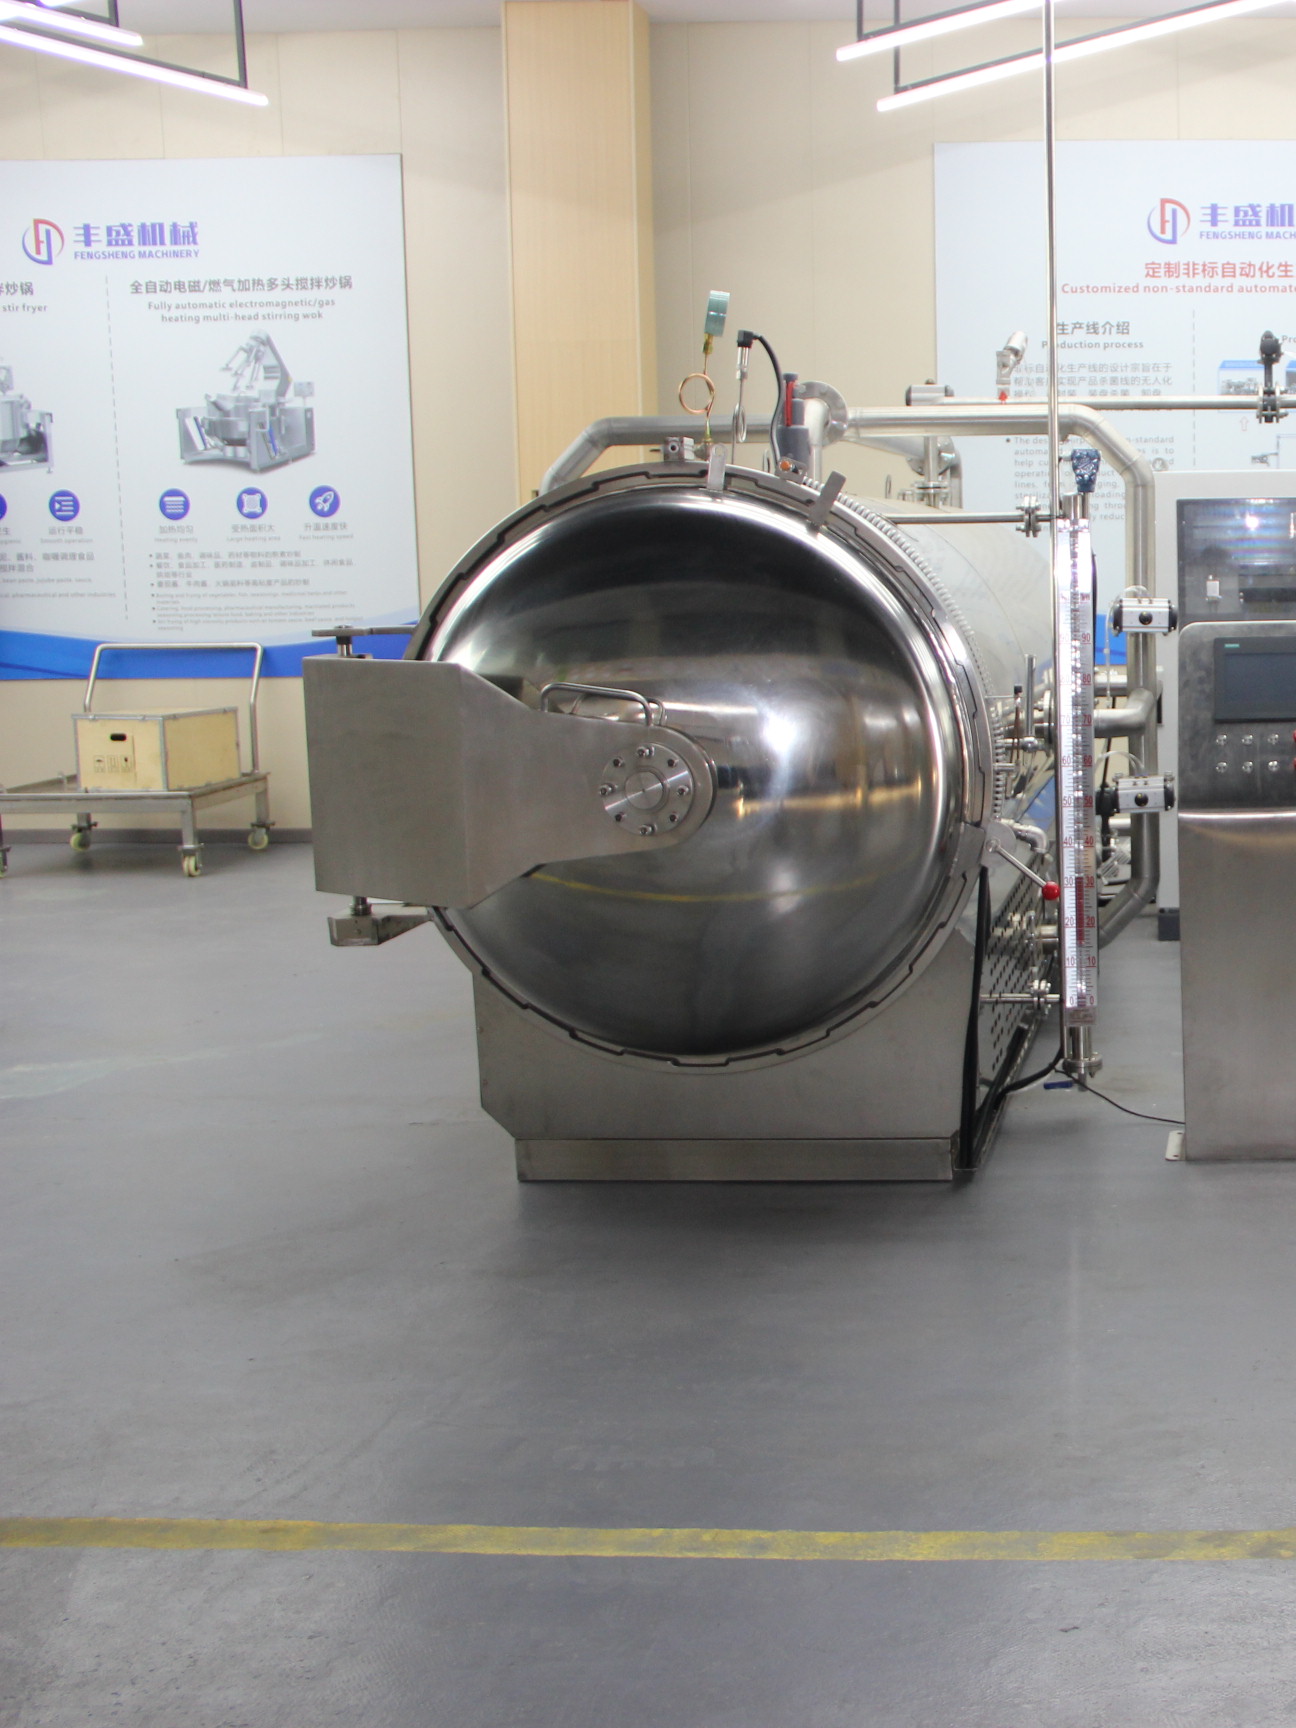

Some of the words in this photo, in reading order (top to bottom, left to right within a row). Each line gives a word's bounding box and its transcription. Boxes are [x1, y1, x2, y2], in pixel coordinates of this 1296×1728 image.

[72, 221, 199, 247] 丰盛机械
[1199, 230, 1263, 240] FENGSHENG
[73, 250, 135, 260] FENGSHENG
[138, 248, 200, 260] MACHINERY
[1061, 282, 1140, 294] Customized
[1143, 282, 1234, 294] non-standard
[2, 303, 20, 312] stir
[22, 303, 48, 314] fryer
[148, 300, 172, 312] Fully
[175, 299, 227, 310] automatic
[229, 297, 336, 309] electromagnetic/gas
[161, 313, 201, 324] heating
[202, 311, 260, 322] multi-head
[262, 310, 300, 322] stirring
[302, 309, 324, 320] wok
[1056, 320, 1131, 336] 生产线介绍
[1042, 340, 1101, 350] Pduction
[1103, 341, 1145, 351] process
[1081, 633, 1091, 643] 90
[1082, 674, 1092, 684] 80
[1083, 715, 1092, 725] 70
[1061, 756, 1071, 766] 60
[1062, 797, 1072, 806] 50
[1063, 837, 1073, 846] 40
[1084, 837, 1094, 846] 40
[1064, 876, 1074, 886] 30
[1085, 876, 1095, 886] 30
[1064, 916, 1074, 926] 20
[1086, 916, 1096, 926] 20
[1066, 957, 1074, 966] 10
[1087, 957, 1096, 966] 10
[1069, 996, 1074, 1006] 0
[1089, 996, 1095, 1006] 0
